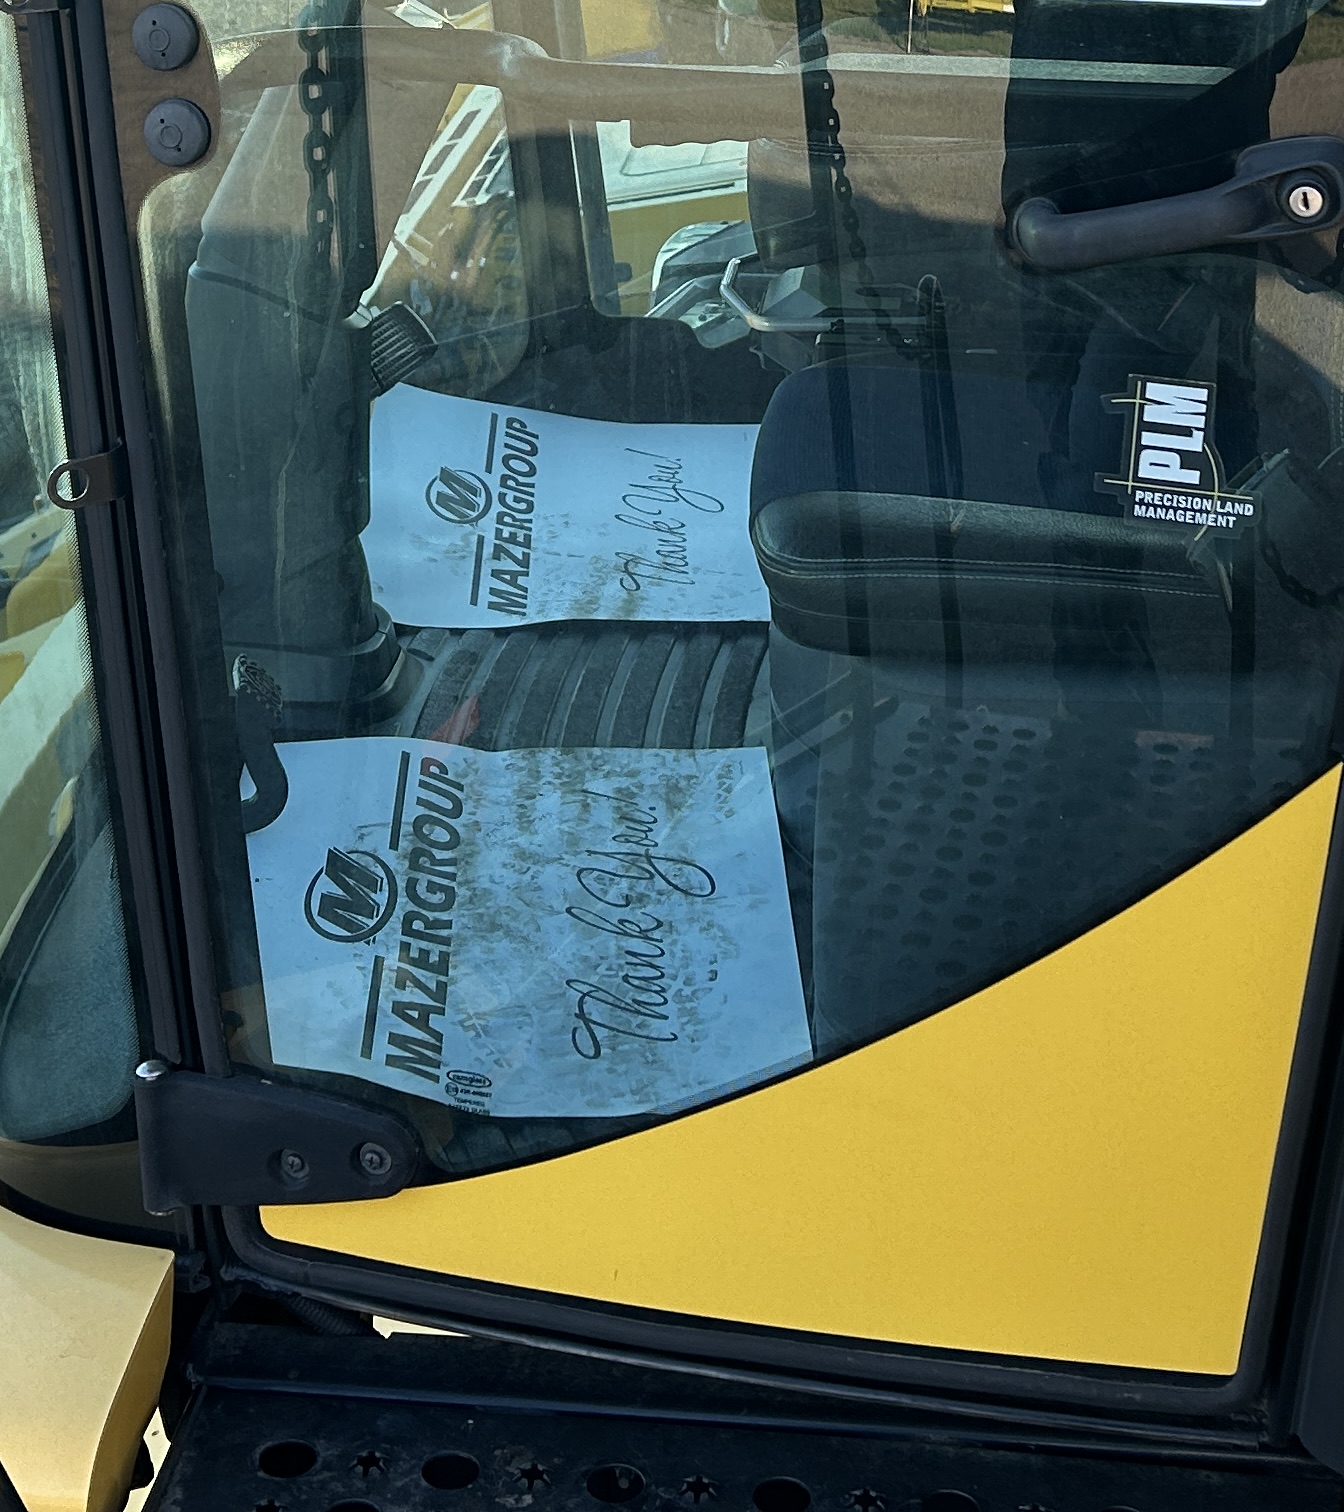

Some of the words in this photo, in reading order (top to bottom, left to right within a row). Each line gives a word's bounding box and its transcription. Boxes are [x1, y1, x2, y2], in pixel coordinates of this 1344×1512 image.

[1137, 381, 1209, 485] PLM
[487, 416, 540, 616] MAZERGROUP
[614, 513, 696, 592] Thank
[1133, 504, 1237, 529] MANAGEMENT
[1134, 490, 1213, 511] PRECISION
[1216, 500, 1254, 516] LAND
[384, 756, 465, 1084] MAZERGROUP
[565, 906, 678, 1059] Thank
